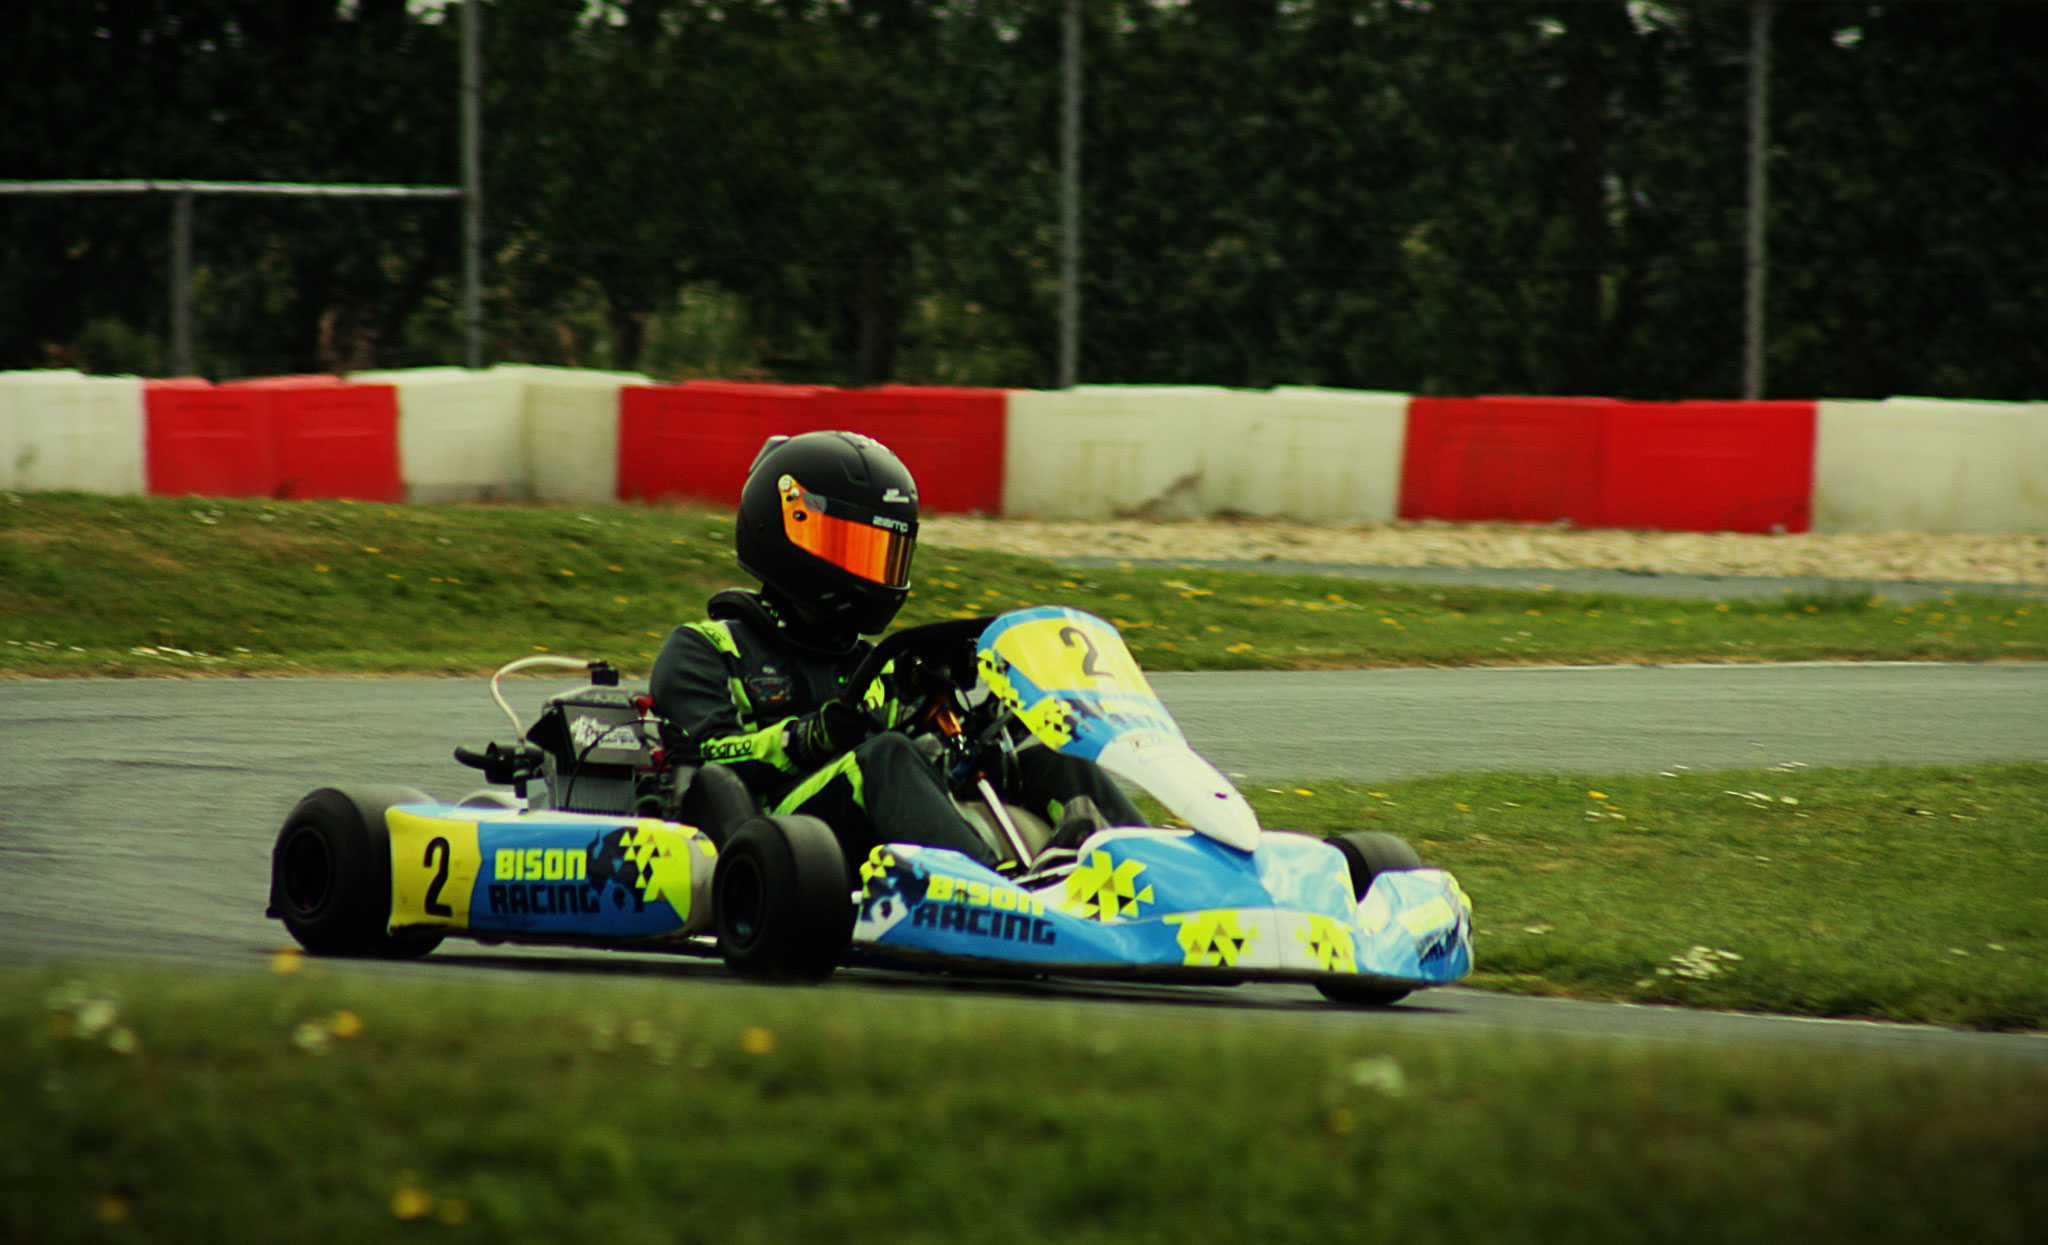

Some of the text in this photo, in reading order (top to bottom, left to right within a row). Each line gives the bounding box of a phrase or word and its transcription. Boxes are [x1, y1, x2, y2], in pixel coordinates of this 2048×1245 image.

[1059, 626, 1114, 678] 2
[423, 837, 453, 918] 2
[495, 849, 588, 881] BISON
[488, 884, 600, 915] RACING
[926, 873, 1045, 916] BISON
[912, 903, 1056, 945] RACING
